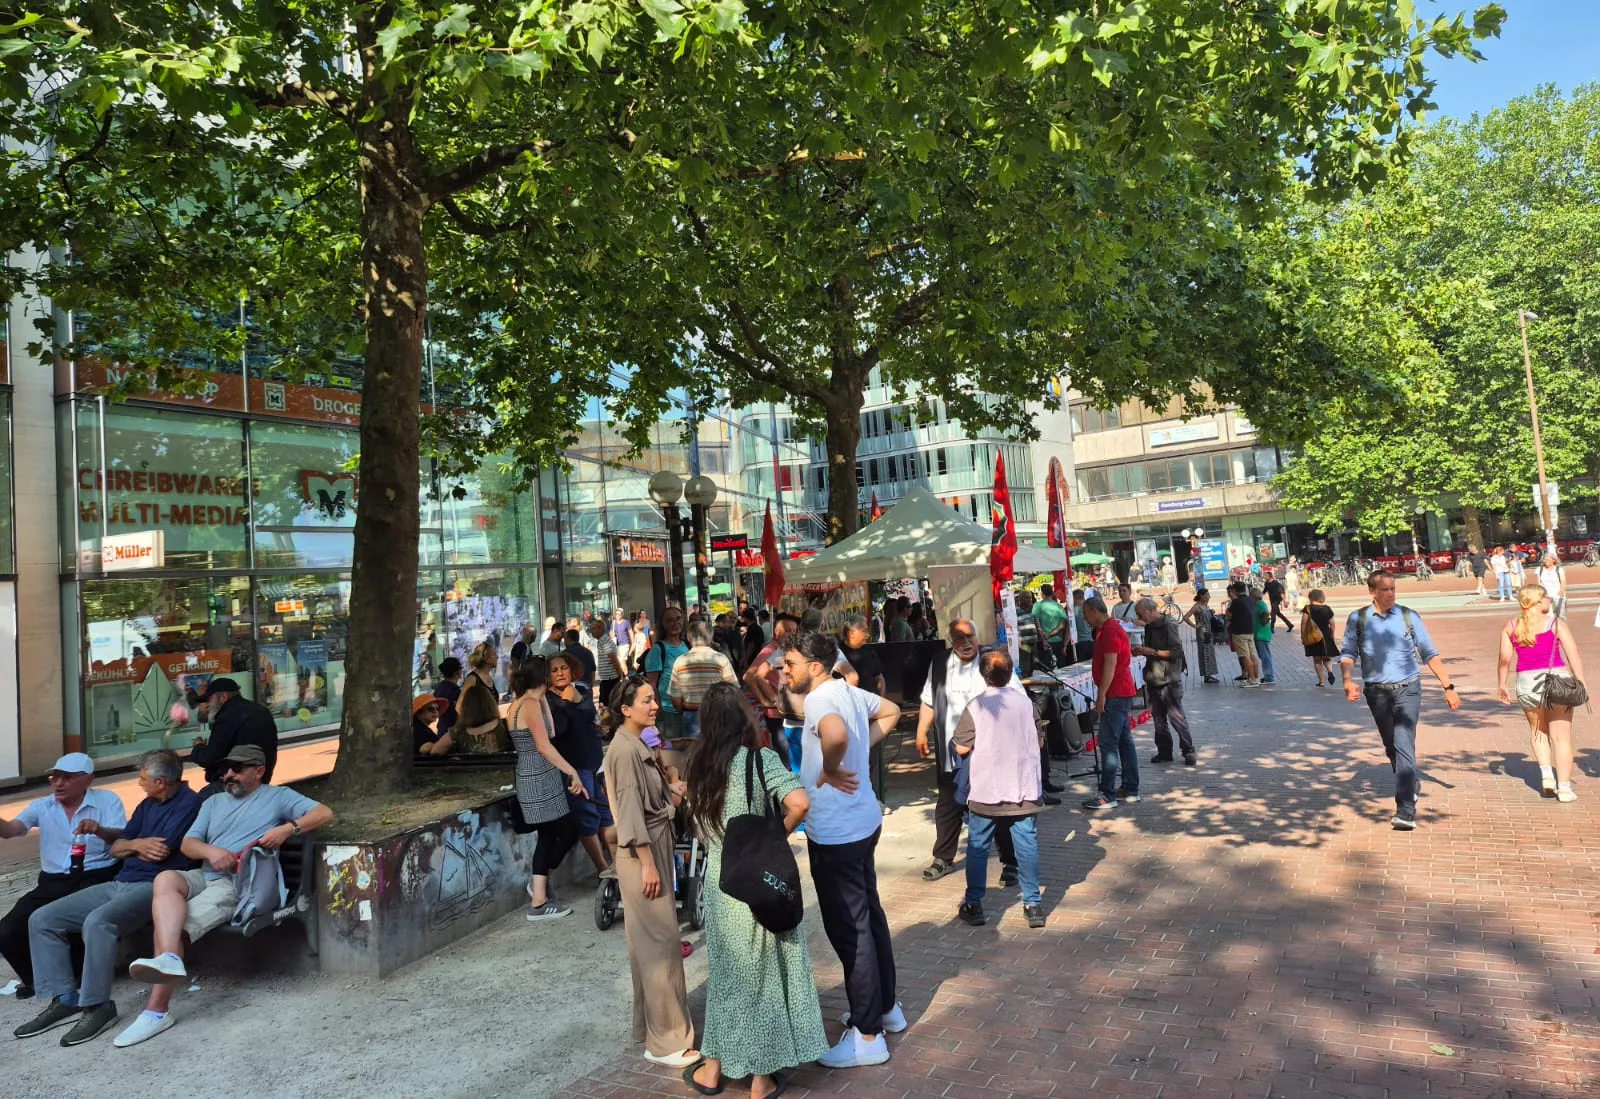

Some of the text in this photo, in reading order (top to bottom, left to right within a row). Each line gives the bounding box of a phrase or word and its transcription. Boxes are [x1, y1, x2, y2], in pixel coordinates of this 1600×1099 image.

[313, 397, 361, 416] DROGE
[115, 544, 152, 560] Müller
[1430, 555, 1452, 565] KFC
